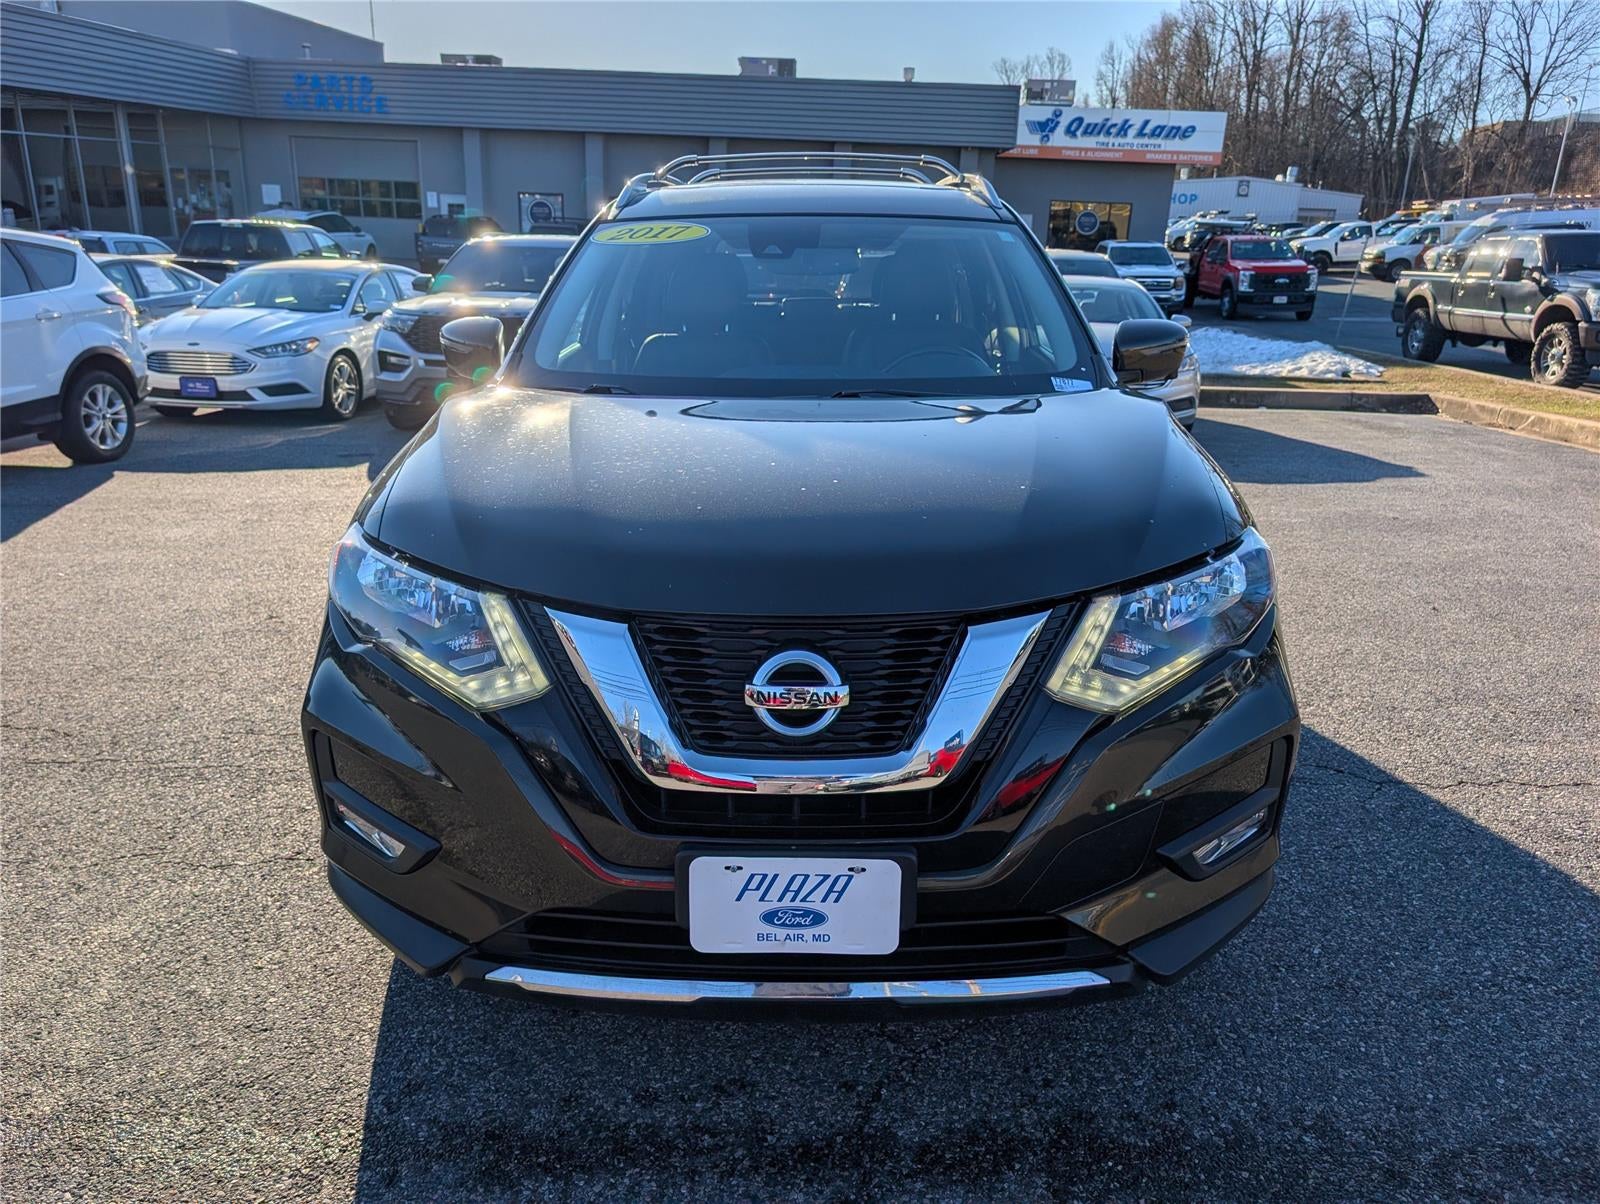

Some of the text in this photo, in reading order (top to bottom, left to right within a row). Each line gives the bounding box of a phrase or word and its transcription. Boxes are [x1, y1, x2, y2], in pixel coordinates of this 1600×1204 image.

[293, 72, 373, 94] PARTS
[283, 91, 390, 113] SERVICE
[1063, 116, 1197, 141] Quick Lane
[1170, 193, 1198, 205] HOP
[607, 225, 693, 241] 2017
[756, 690, 839, 705] NISSAN
[734, 872, 855, 904] PLAZA
[773, 909, 815, 926] Ford
[756, 932, 831, 944] BEL AIR, MD
